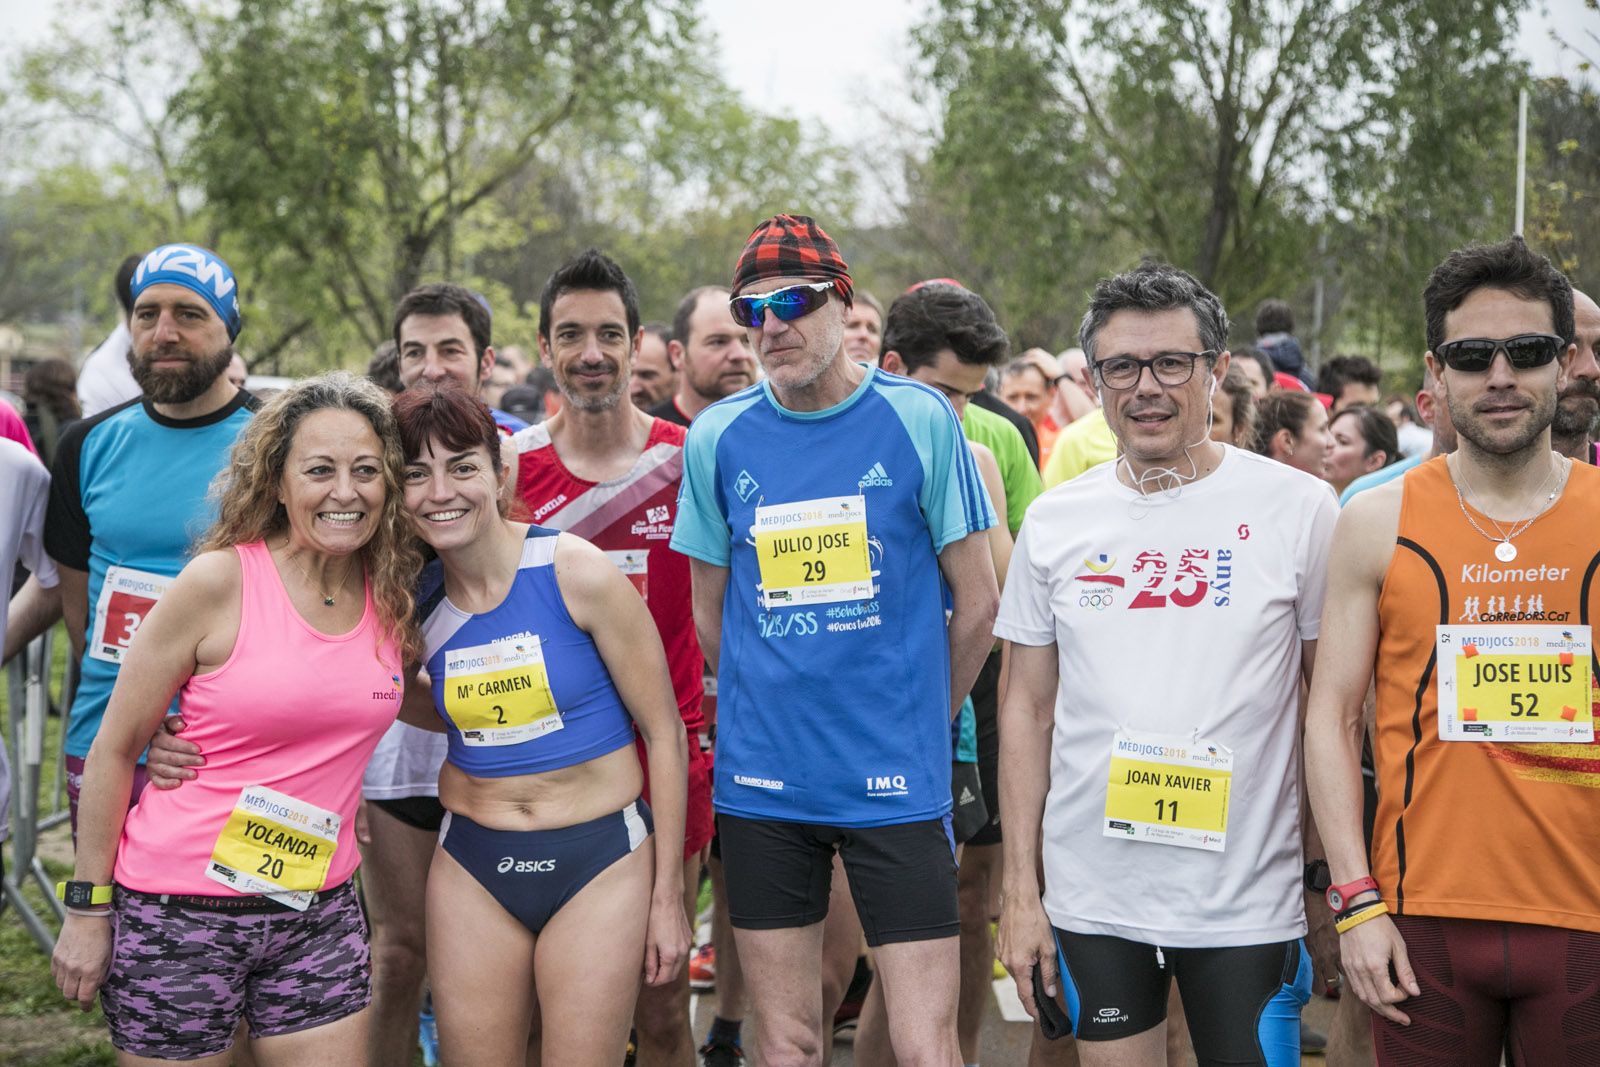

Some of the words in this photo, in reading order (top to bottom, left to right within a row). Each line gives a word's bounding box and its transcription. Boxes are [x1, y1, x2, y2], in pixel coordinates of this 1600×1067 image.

[533, 494, 567, 520] Joma
[773, 536, 813, 558] JULIO
[817, 532, 850, 554] JOSE
[802, 560, 826, 582] 29
[1209, 550, 1233, 607] anys
[1461, 564, 1570, 583] Kilometer
[1442, 633, 1451, 644] 52
[478, 675, 532, 697] CARMEN
[1473, 663, 1521, 687] JOSE
[1529, 663, 1572, 683] LUIS
[492, 705, 508, 725] 2
[1510, 693, 1539, 717] 52
[866, 775, 908, 790] IMQ
[1125, 769, 1161, 786] JOAN
[1165, 774, 1211, 792] XAVIER
[1154, 798, 1179, 822] 11
[243, 820, 318, 860] YOLANDA
[257, 853, 284, 879] 20
[514, 859, 556, 873] asics
